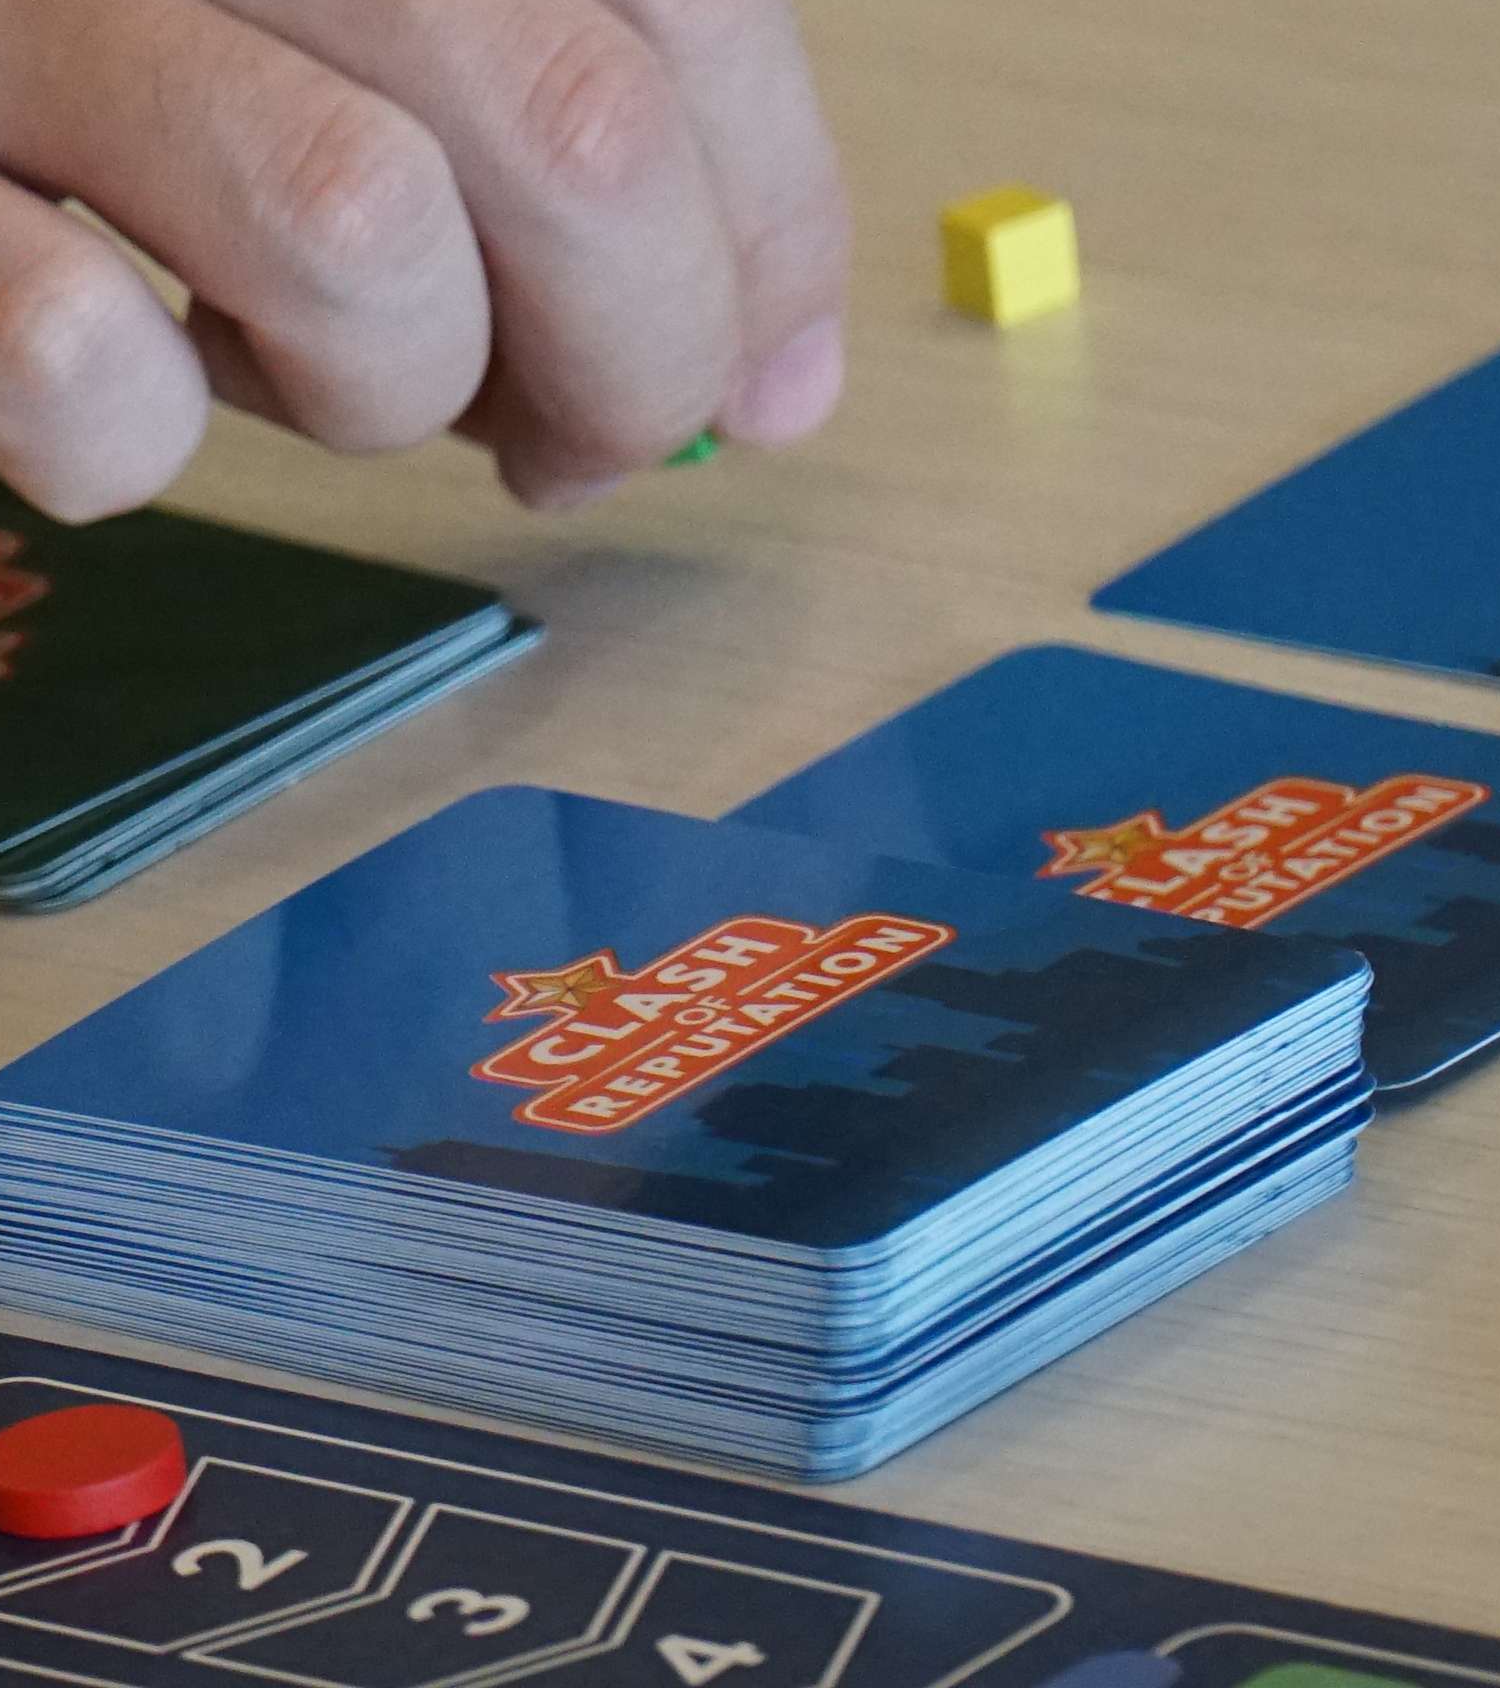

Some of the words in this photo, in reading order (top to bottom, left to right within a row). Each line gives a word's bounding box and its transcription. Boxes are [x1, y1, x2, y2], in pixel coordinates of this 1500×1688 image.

[1096, 793, 1320, 906] LASH
[528, 933, 780, 1065] CLASH
[566, 926, 927, 1119] REPUTATION
[674, 994, 731, 1027] OF
[171, 1537, 309, 1591] 2
[405, 1587, 532, 1638] 3
[654, 1633, 769, 1687] 4
